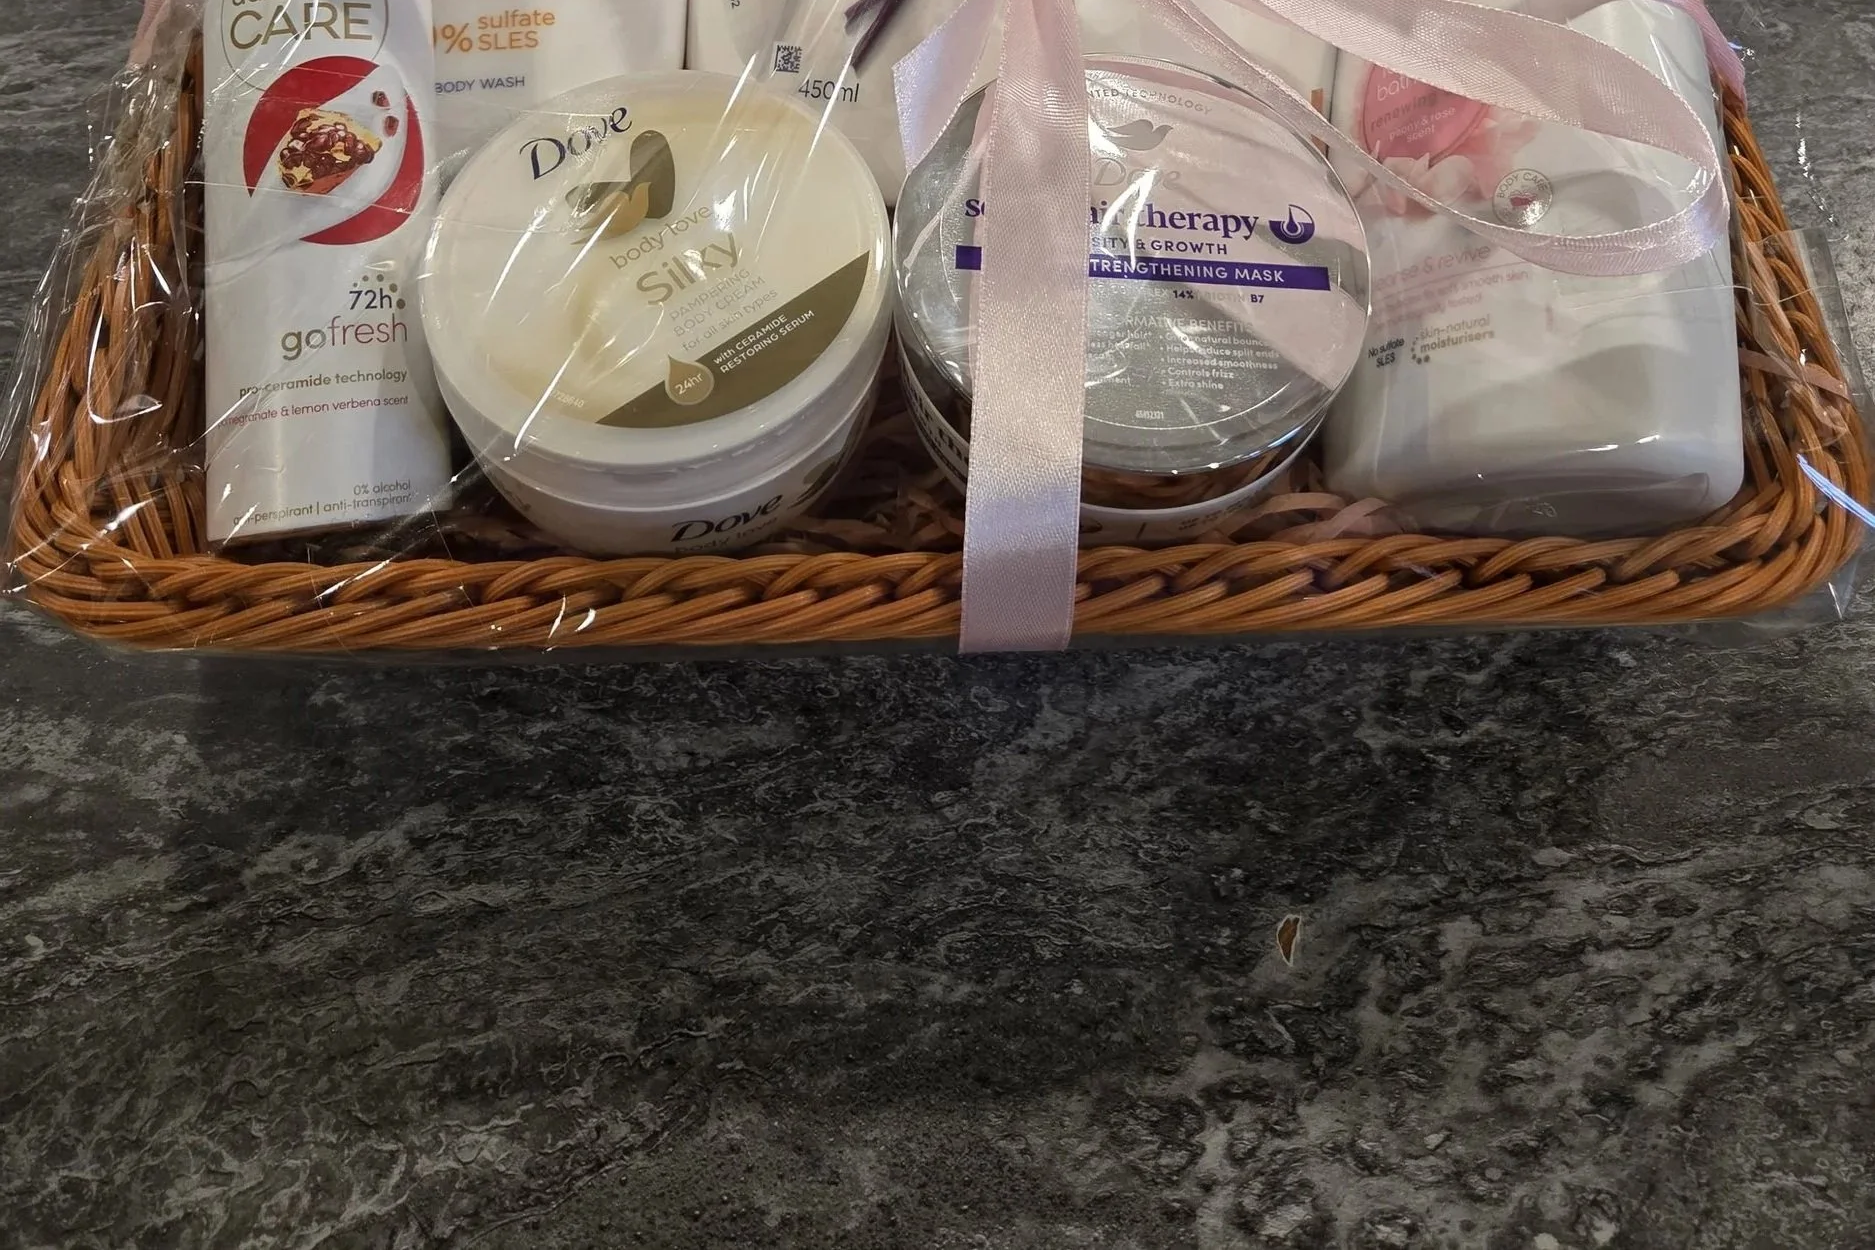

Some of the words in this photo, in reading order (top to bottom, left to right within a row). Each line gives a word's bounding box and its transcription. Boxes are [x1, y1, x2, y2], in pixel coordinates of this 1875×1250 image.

[230, 1, 373, 50] CARE
[477, 9, 556, 31] sulfate
[477, 30, 541, 51] SLES
[480, 76, 525, 90] WASH
[798, 78, 860, 103] 450ml
[519, 106, 633, 181] Dove
[1093, 157, 1181, 191] Doe
[608, 227, 666, 270] body
[664, 205, 713, 238] love
[1091, 236, 1129, 249] SITY
[1150, 239, 1228, 255] GROWTH
[635, 231, 740, 306] Silky
[1090, 257, 1228, 280] TRENGTHENING
[1234, 267, 1285, 283] MASK
[349, 287, 393, 311] 72h
[669, 268, 751, 321] PAMPERING
[673, 308, 713, 337] BODY
[715, 276, 766, 311] CREAM
[1172, 289, 1195, 300] 14%
[1250, 293, 1265, 303] B7
[682, 337, 701, 351] for
[702, 326, 718, 339] all
[718, 309, 744, 330] skin
[742, 288, 778, 314] types
[1419, 313, 1491, 341] skin-natural
[281, 313, 408, 361] gofresh
[713, 348, 736, 365] with
[735, 314, 788, 350] CERAMIDE
[719, 334, 779, 374] RESTORING
[778, 309, 815, 336] SERUM
[1419, 329, 1495, 354] moisturisers
[239, 372, 331, 399] pro-ceramide
[335, 369, 408, 384] technology
[675, 373, 703, 396] 24hr
[281, 405, 290, 417] &
[291, 401, 330, 416] lemon
[332, 395, 381, 412] verbena
[383, 395, 409, 406] scent
[353, 483, 369, 496] 0%
[372, 479, 411, 494] alcohol
[671, 494, 783, 542] Dove
